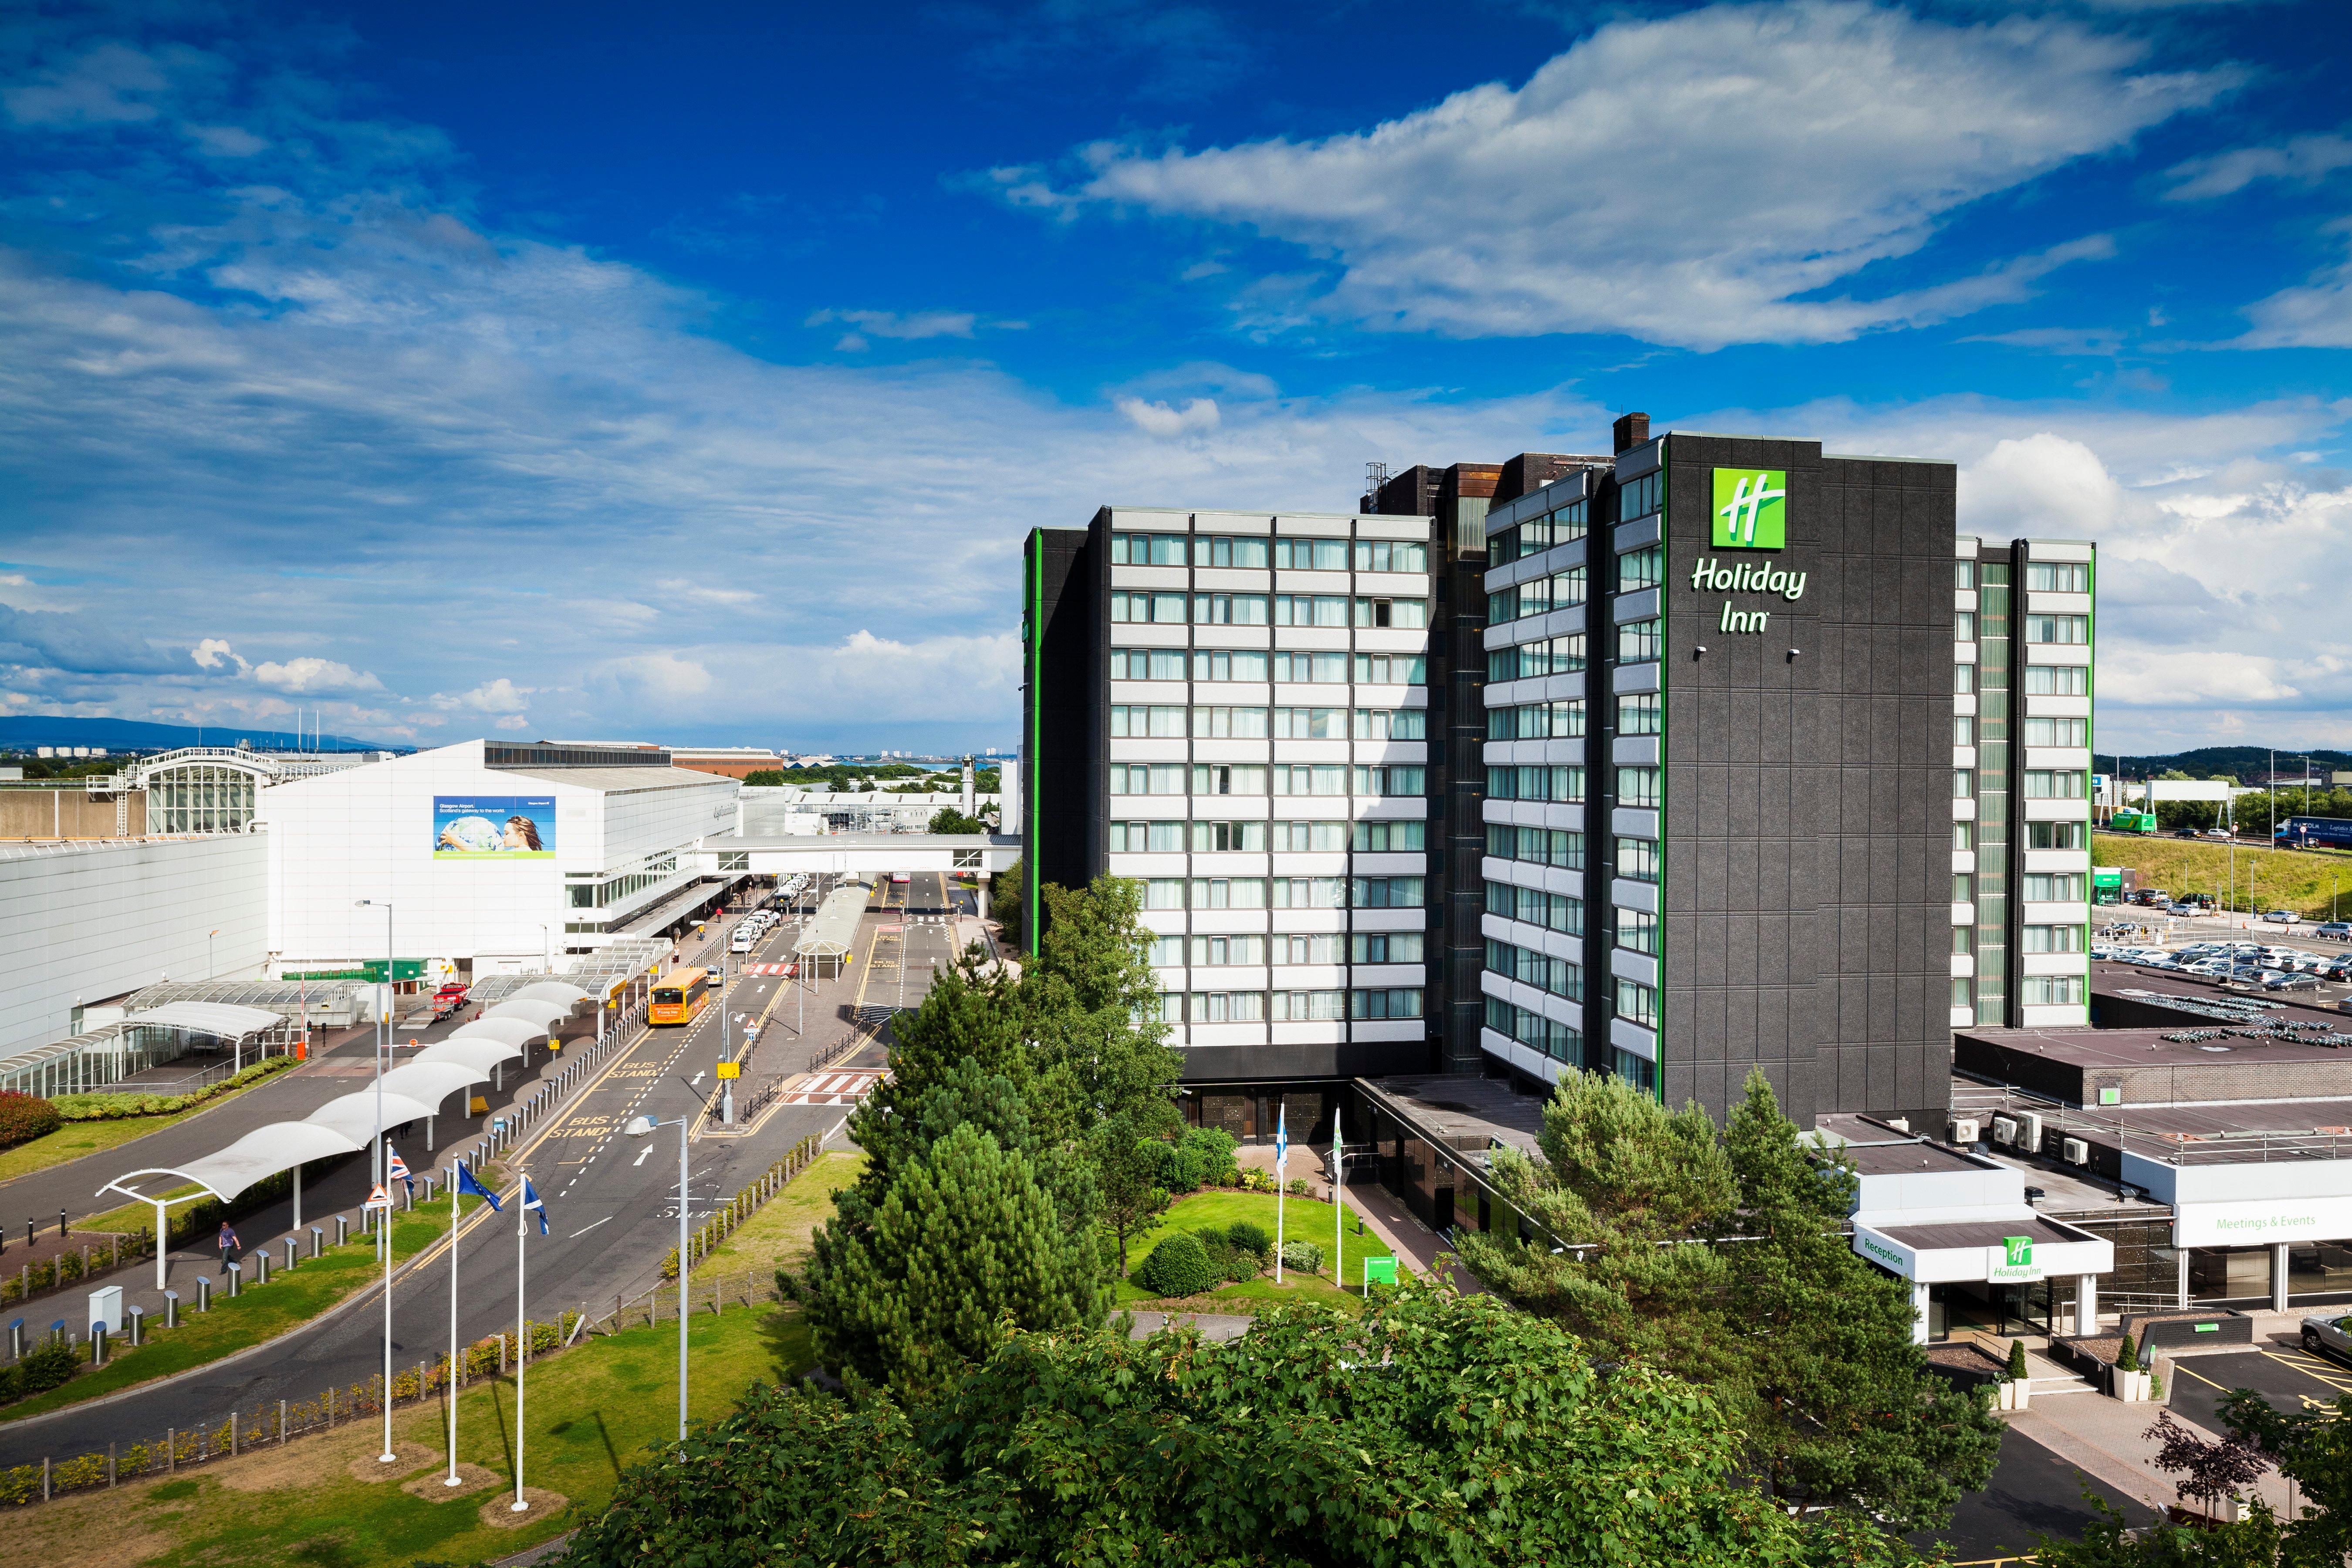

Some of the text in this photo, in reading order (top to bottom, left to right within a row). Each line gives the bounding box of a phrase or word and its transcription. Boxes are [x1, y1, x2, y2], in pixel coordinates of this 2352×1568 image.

[1691, 558, 1807, 600] Holiday
[1720, 600, 1770, 632] Inn
[608, 1069, 657, 1078] STAND
[568, 1116, 611, 1126] BUS
[549, 1127, 608, 1138] STAND
[2217, 1216, 2316, 1230] Meetings & Events
[1865, 1238, 1903, 1266] Reception
[1994, 1266, 2041, 1278] Holiday Inn
